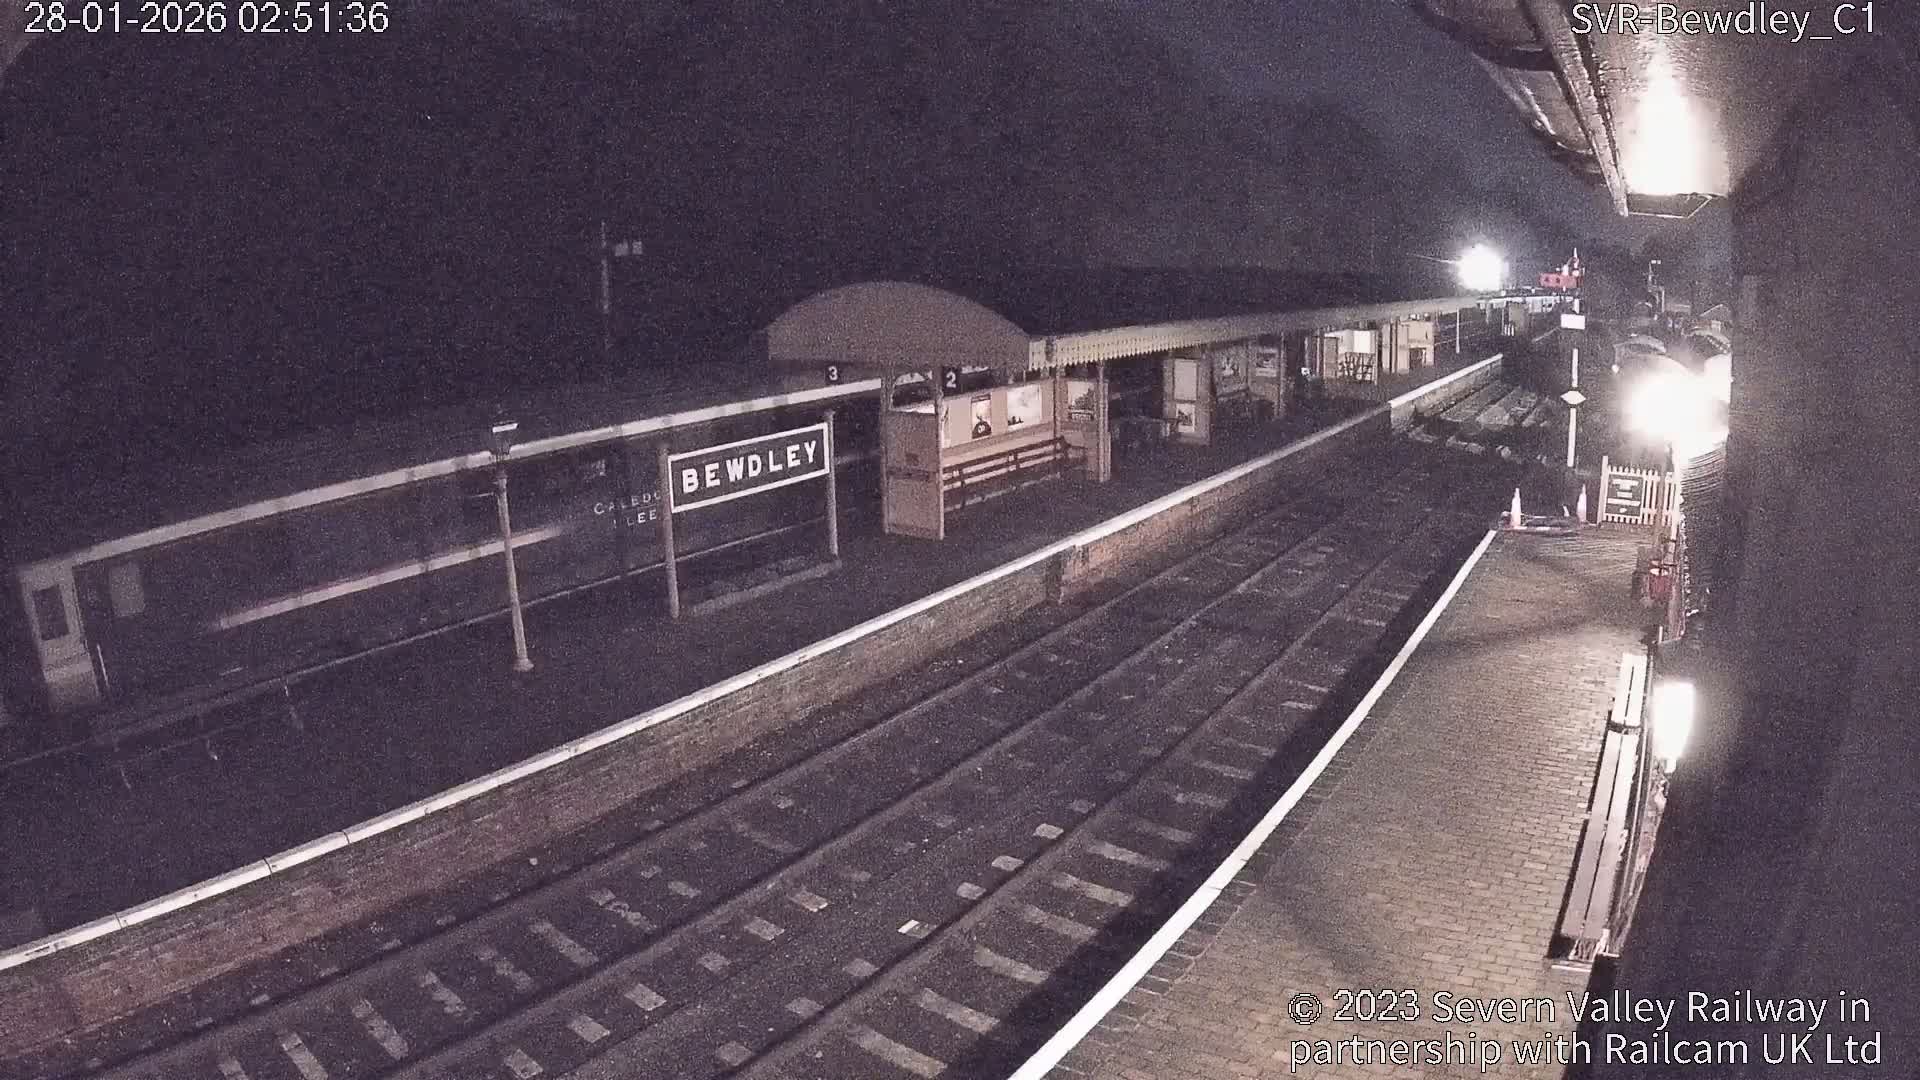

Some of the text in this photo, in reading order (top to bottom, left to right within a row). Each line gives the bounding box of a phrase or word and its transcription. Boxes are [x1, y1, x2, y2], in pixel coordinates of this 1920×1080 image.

[827, 365, 839, 381] 3
[945, 371, 957, 388] 2
[681, 440, 817, 494] BEWDLEY
